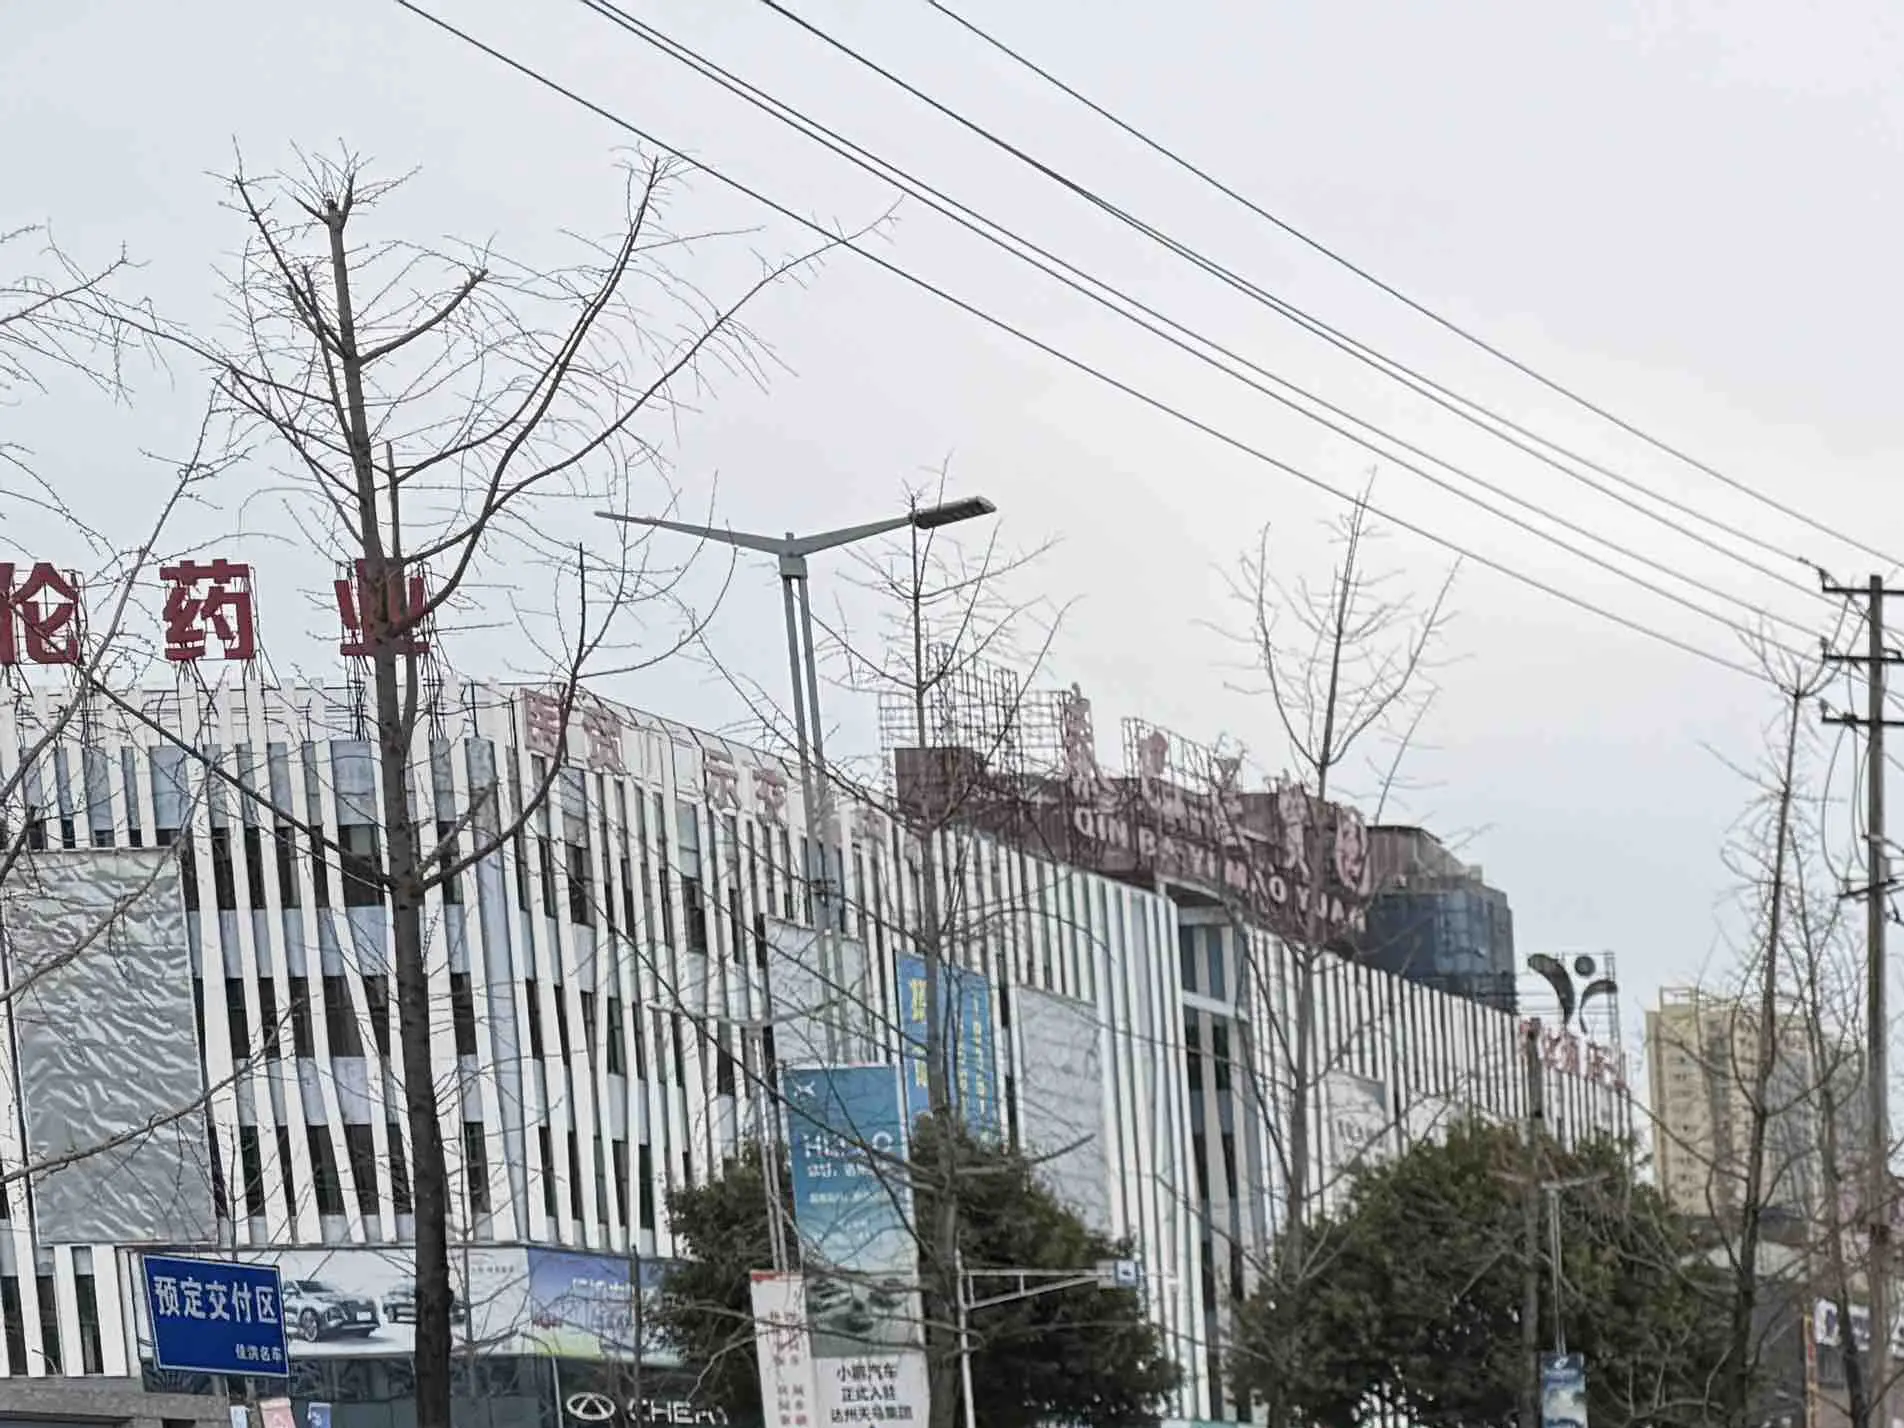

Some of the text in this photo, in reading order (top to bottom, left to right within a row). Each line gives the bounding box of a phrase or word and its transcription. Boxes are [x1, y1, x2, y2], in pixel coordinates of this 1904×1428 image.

[0, 558, 434, 666] 伦药业
[152, 1275, 279, 1324] 预定交付区
